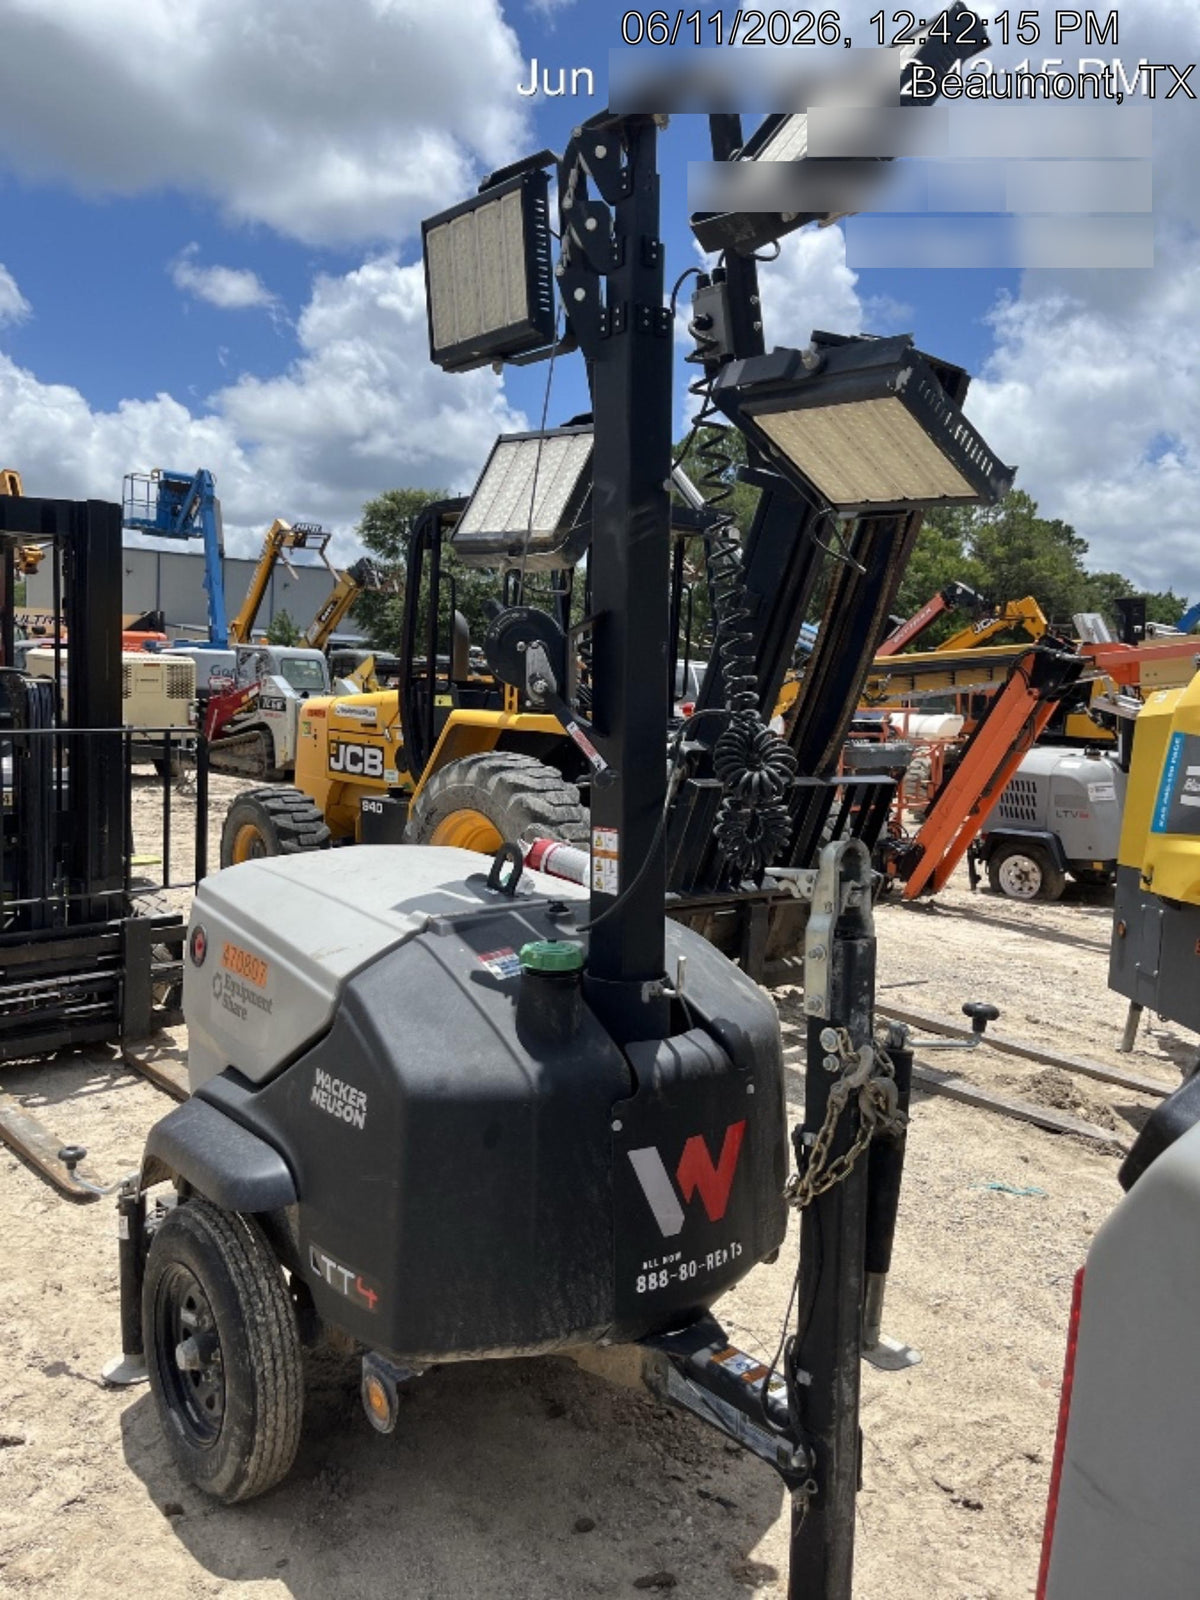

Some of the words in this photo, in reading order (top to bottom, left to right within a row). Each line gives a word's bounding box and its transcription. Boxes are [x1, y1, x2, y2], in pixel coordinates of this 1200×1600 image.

[329, 743, 383, 776] JCB
[222, 992, 248, 1021] Share
[224, 973, 272, 1015] Equipment
[310, 1085, 367, 1130] NEUSON
[315, 1067, 367, 1111] WACKER
[309, 1245, 378, 1309] LTT4
